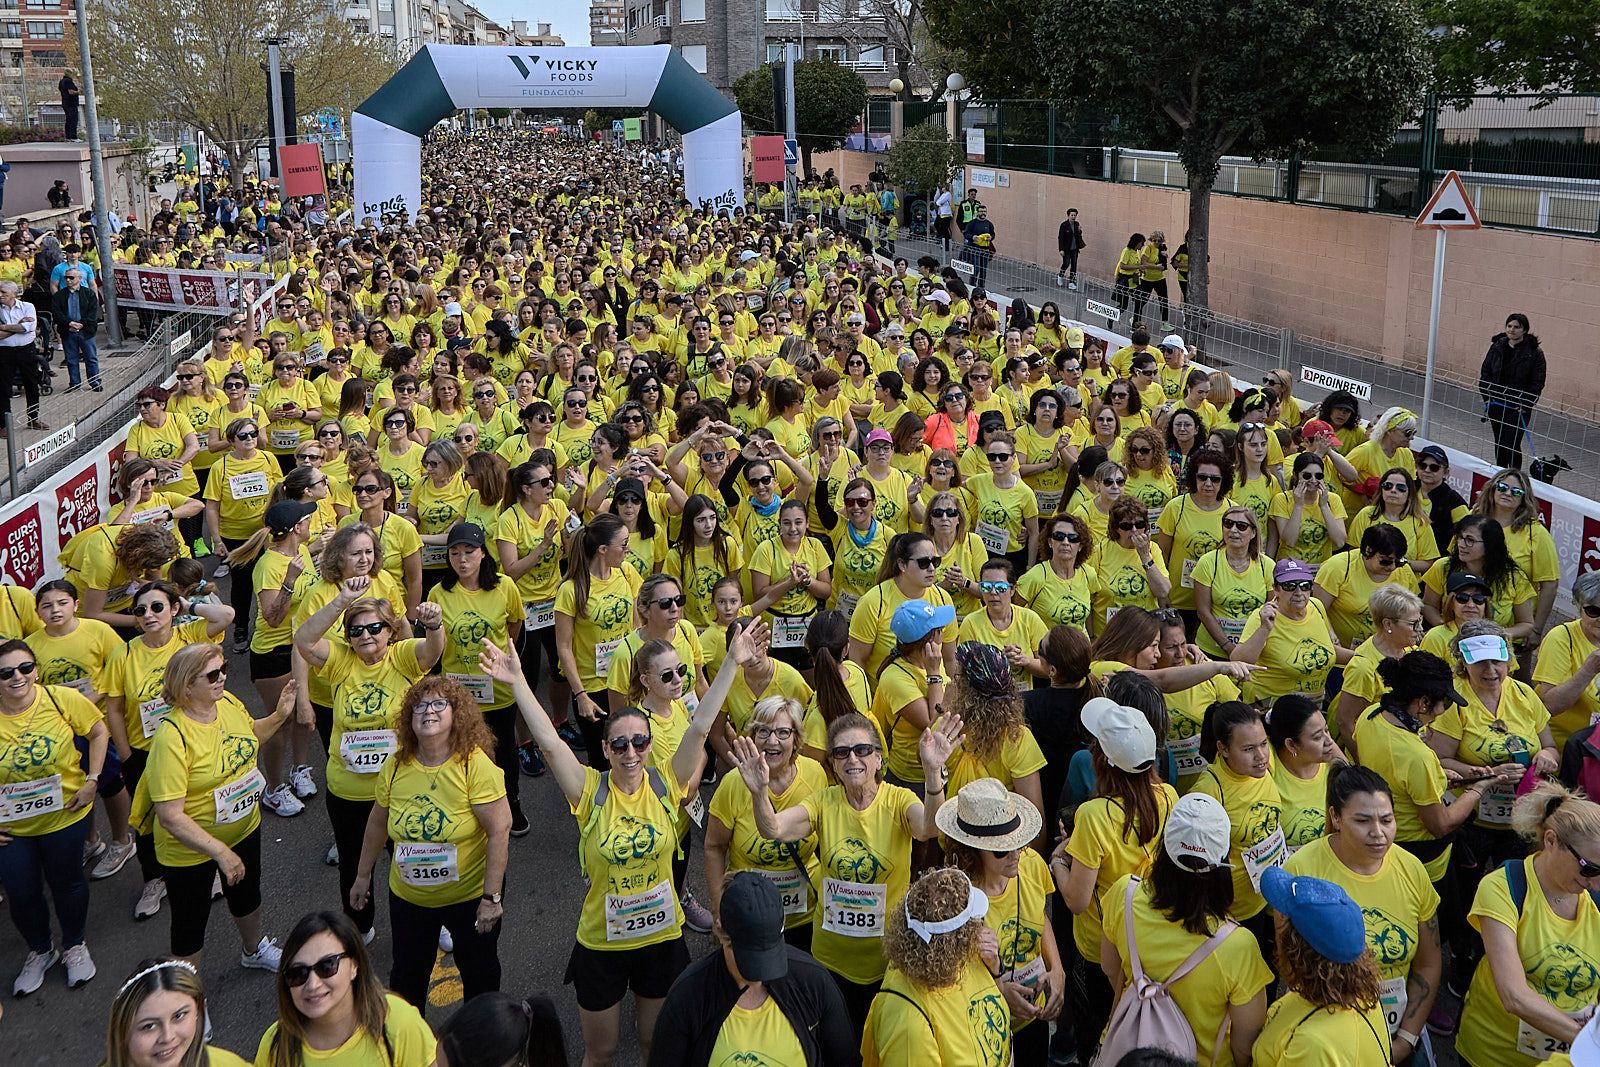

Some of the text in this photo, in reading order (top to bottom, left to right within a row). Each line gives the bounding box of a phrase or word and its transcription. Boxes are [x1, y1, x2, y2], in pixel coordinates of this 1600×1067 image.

[546, 60, 598, 71] VICKY
[551, 73, 593, 82] FOODS
[522, 87, 584, 96] FUNDACIÓN
[288, 165, 319, 174] CAMINANTS
[363, 197, 407, 215] be plus
[714, 192, 737, 209] plus
[1092, 301, 1119, 319] PROINBENI
[1313, 372, 1368, 397] PROINBENI
[36, 429, 74, 461] PROINBENI
[74, 477, 97, 499] CURSA
[242, 484, 263, 493] 4252
[76, 487, 97, 512] DE LA
[78, 498, 97, 522] DONA
[8, 518, 39, 544] CURSA
[10, 530, 39, 558] DE LA
[12, 542, 40, 571] DONA
[537, 611, 554, 623] 806
[786, 632, 804, 642] 807
[600, 645, 610, 653] XV
[144, 702, 155, 713] XV
[345, 735, 357, 744] XV
[355, 753, 389, 765] 4197
[1, 786, 15, 795] XV
[219, 787, 232, 799] XV
[15, 796, 54, 813] 3768
[232, 790, 260, 814] 4198
[400, 846, 412, 857] XV
[1180, 842, 1207, 853] makita
[1245, 849, 1259, 863] XV
[412, 867, 449, 879] 3166
[827, 882, 839, 895] XV
[839, 887, 853, 895] CURSA
[610, 897, 623, 909] XV
[624, 899, 641, 907] CURSA
[625, 910, 666, 931] 2369
[837, 910, 876, 927] 1383
